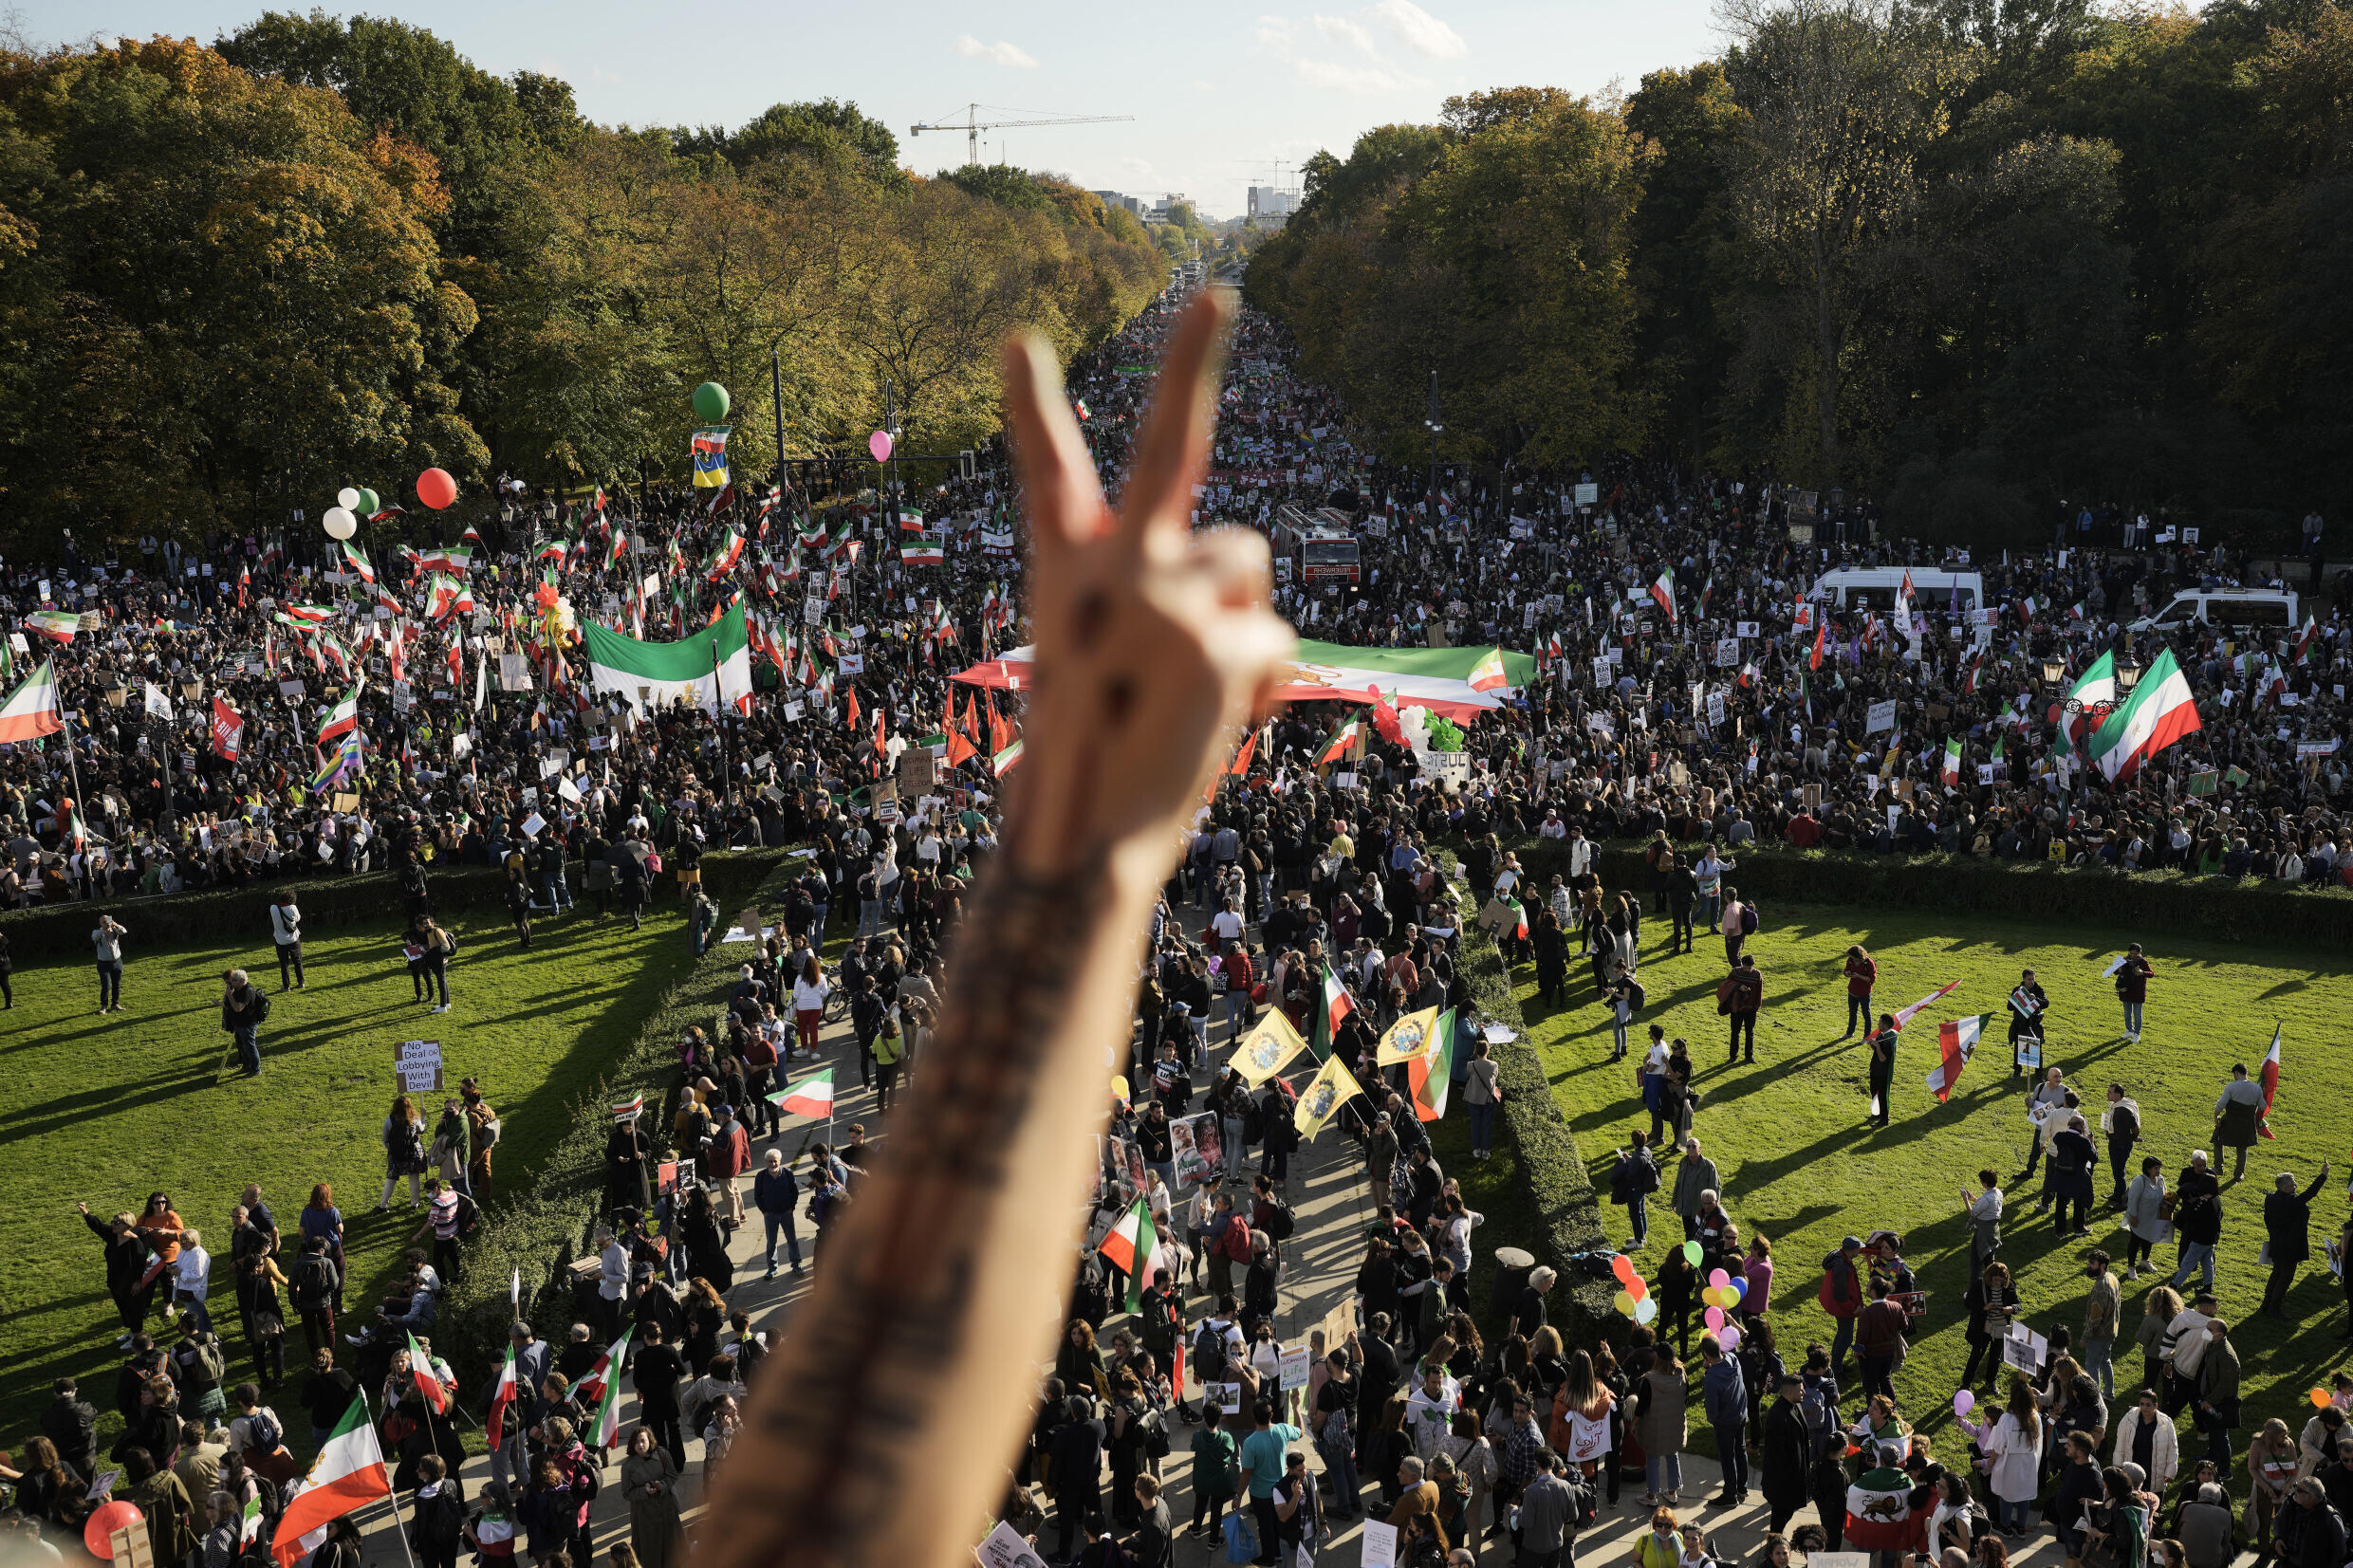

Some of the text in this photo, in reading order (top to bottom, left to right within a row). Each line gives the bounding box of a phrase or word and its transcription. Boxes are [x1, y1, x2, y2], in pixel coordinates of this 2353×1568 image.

[42, 582, 47, 593] P
[909, 766, 926, 776] LIFE
[405, 1049, 426, 1060] Deal
[398, 1060, 440, 1071] Lobbying
[407, 1072, 430, 1080] With
[409, 1079, 433, 1090] Devil
[1179, 1165, 1198, 1174] LIFE
[1575, 1430, 1603, 1448] آزادی
